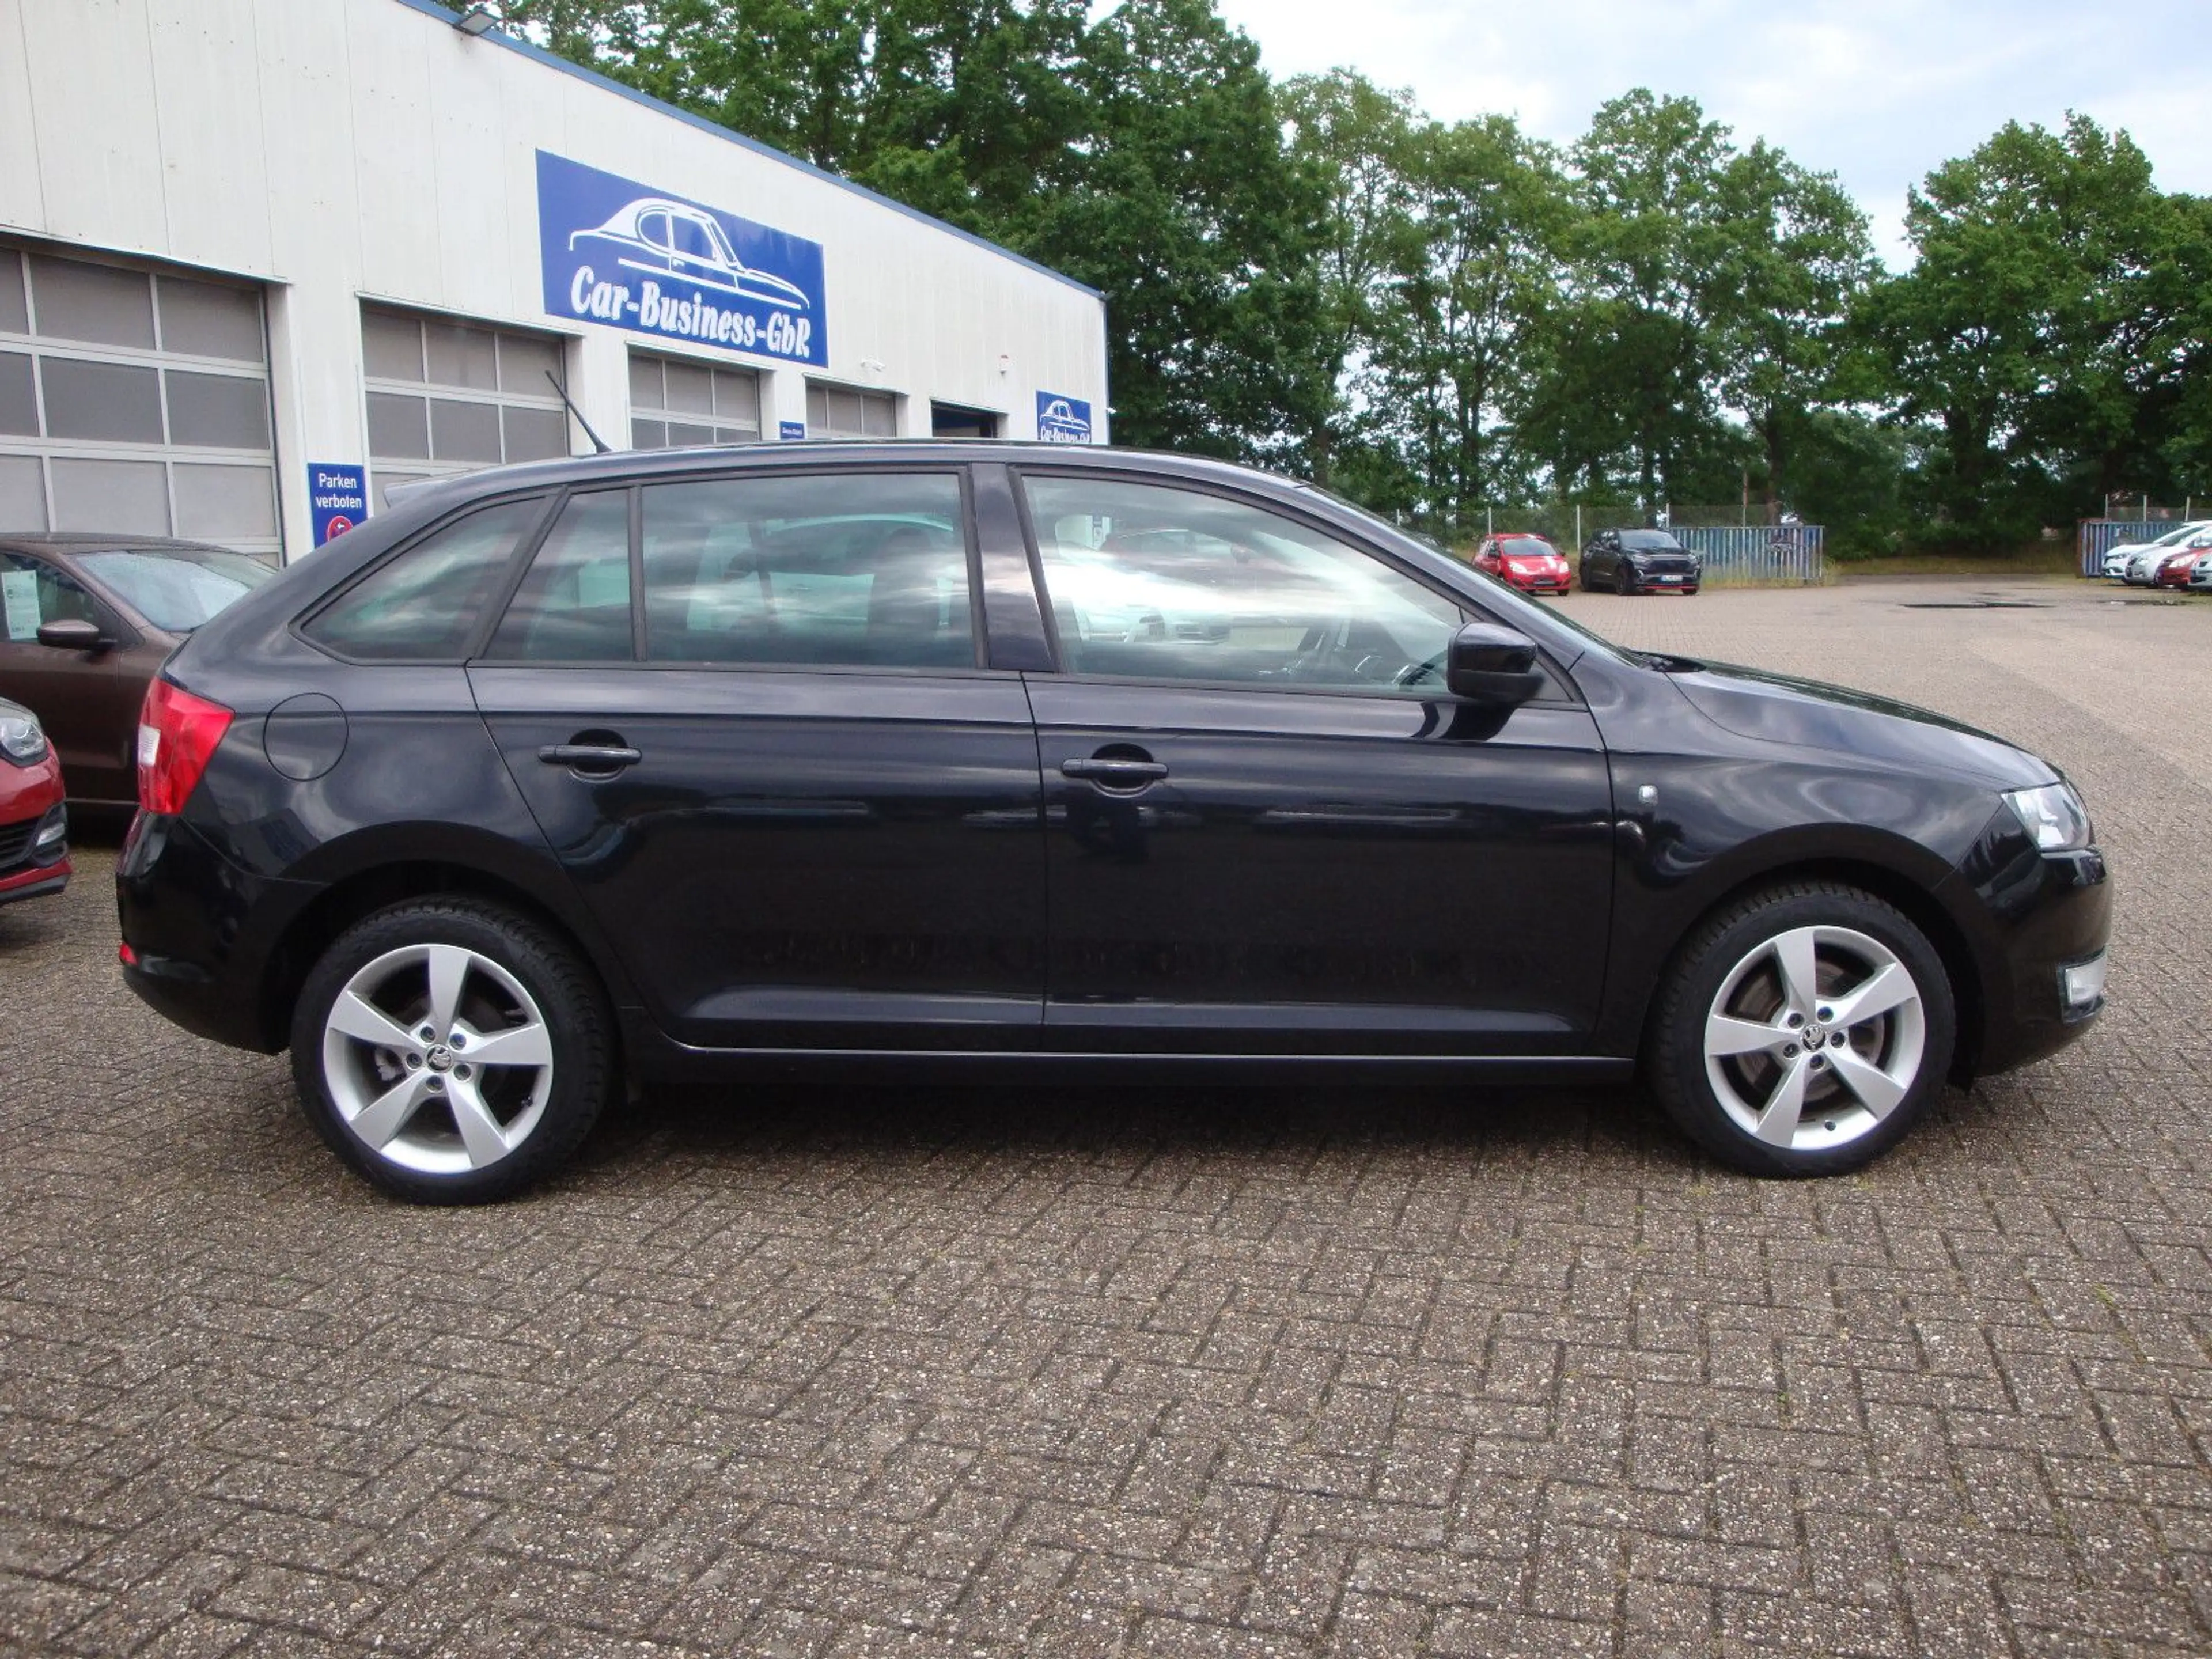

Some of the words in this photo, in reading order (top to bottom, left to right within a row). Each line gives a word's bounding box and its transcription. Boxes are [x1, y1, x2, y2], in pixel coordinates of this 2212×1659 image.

[570, 265, 811, 358] Car-Business-GbR
[319, 472, 357, 488] Parken
[315, 493, 362, 509] verboten
